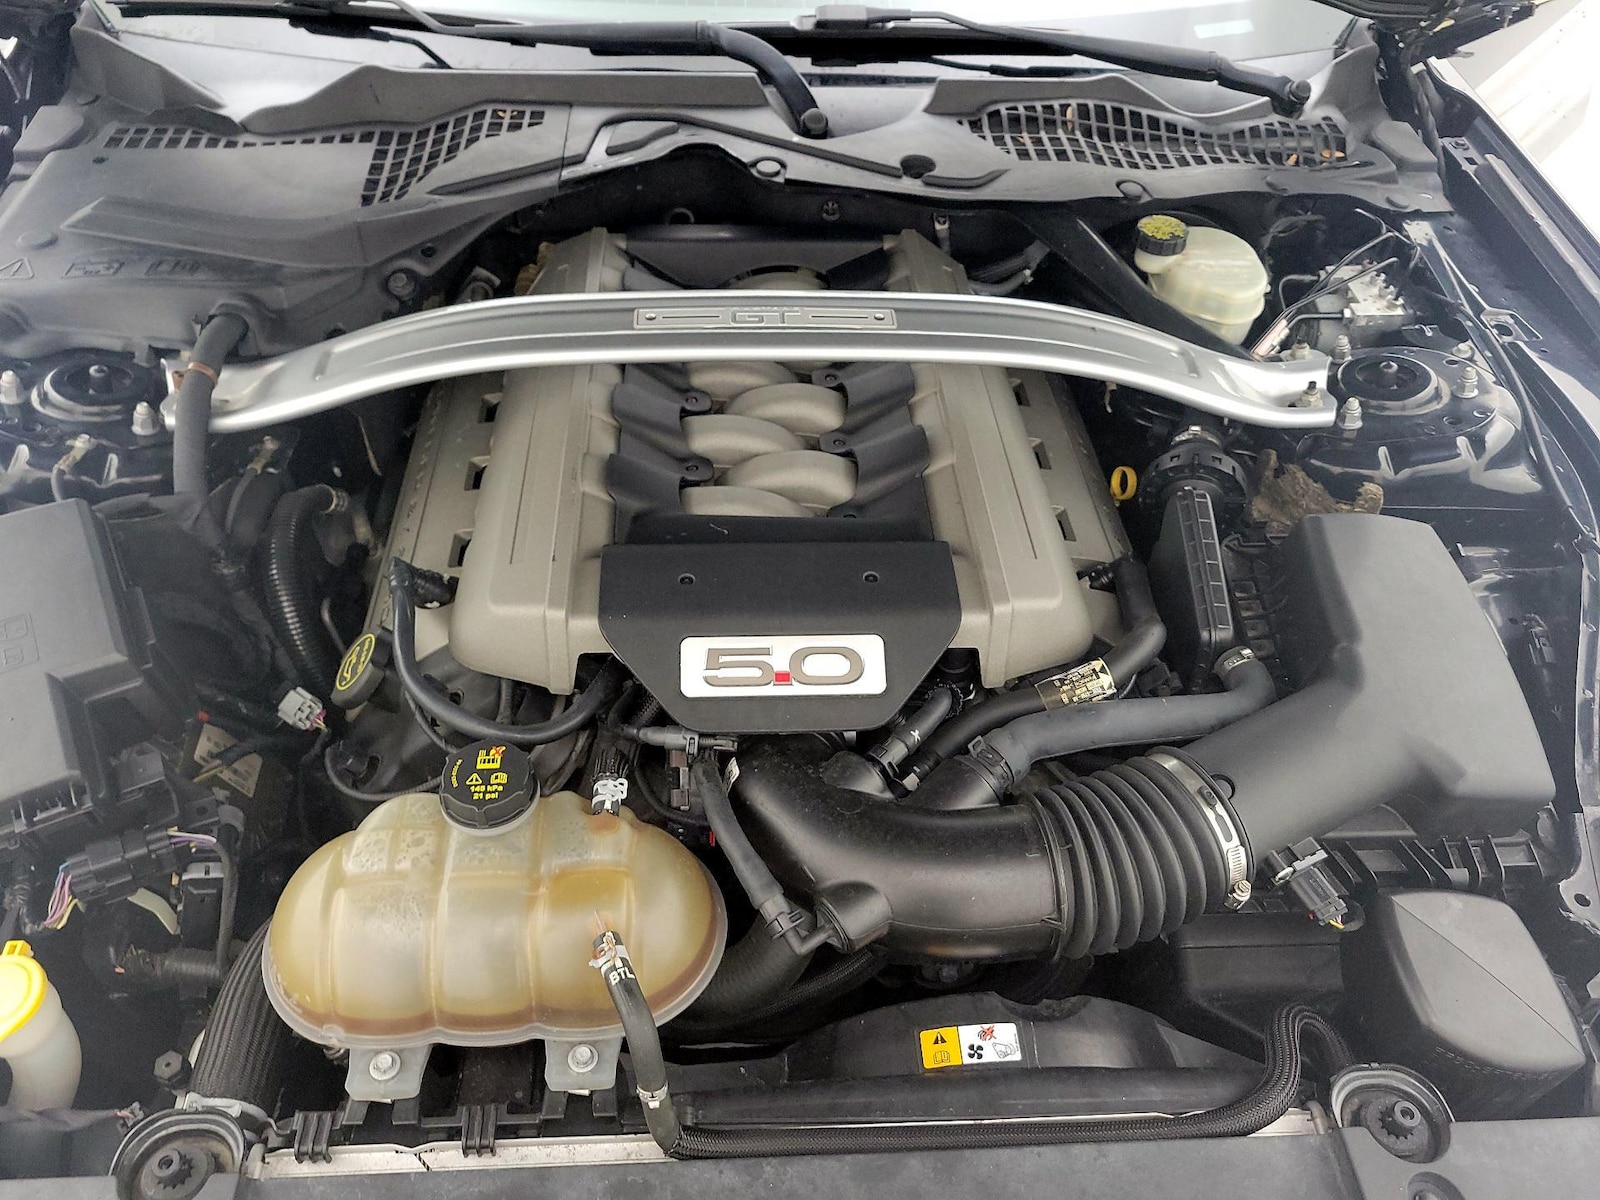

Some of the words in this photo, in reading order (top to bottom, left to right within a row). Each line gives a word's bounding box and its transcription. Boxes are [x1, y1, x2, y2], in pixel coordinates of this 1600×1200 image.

[730, 308, 801, 325] GT
[702, 645, 865, 688] 5.0
[472, 792, 484, 800] 21
[485, 791, 499, 801] psi
[487, 784, 504, 792] kPa
[608, 966, 636, 986] BTL
